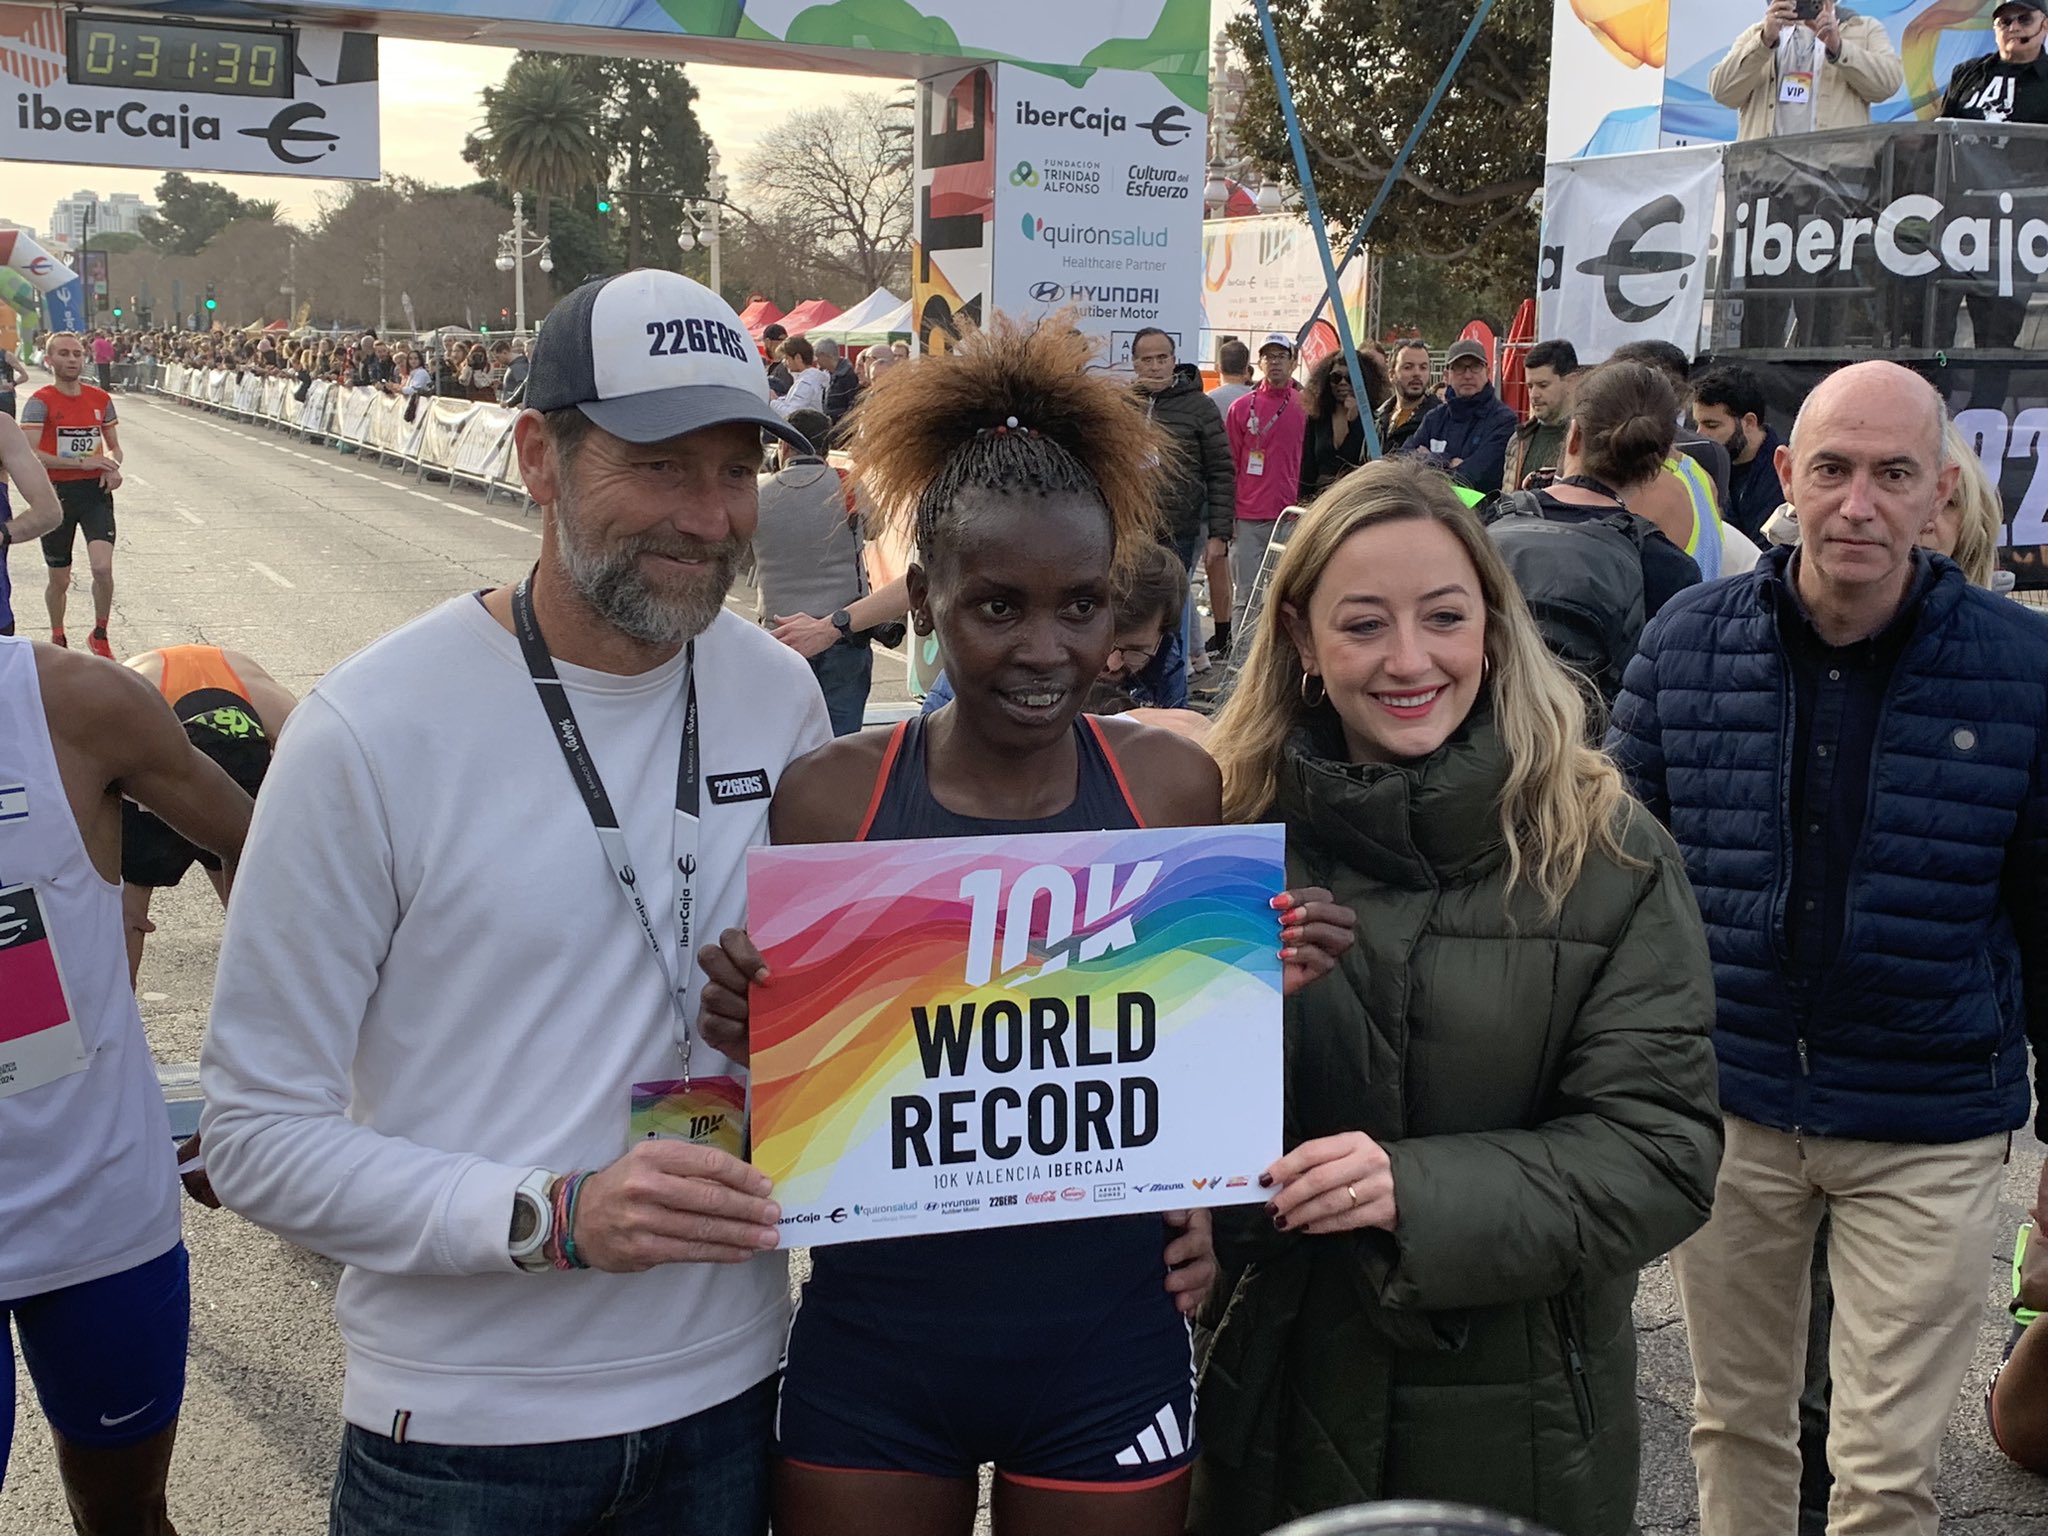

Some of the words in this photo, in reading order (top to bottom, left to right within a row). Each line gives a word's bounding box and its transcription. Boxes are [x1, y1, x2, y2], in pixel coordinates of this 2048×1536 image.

[86, 31, 277, 87] 0:31:30
[1786, 86, 1805, 97] VIP
[18, 92, 221, 149] iberCaja
[1016, 101, 1127, 137] iberCaja
[1044, 168, 1101, 183] TRINIDAD
[1128, 164, 1177, 183] Cultura
[1177, 173, 1190, 184] del
[1044, 182, 1101, 195] ALFONSO
[1126, 180, 1190, 200] Esfuerzo
[1043, 224, 1168, 250] quirónsalud
[1062, 255, 1123, 271] Healthcare
[1125, 258, 1167, 272] Partner
[1070, 285, 1159, 304] HYUNDAI
[1120, 306, 1159, 320] Motor
[646, 318, 748, 363] 226ERS
[71, 439, 93, 452] 692
[581, 765, 597, 791] BANCO
[714, 776, 763, 798] 226ERS
[679, 887, 694, 948] iberCaja
[958, 861, 1164, 988] 10K
[910, 991, 1156, 1079] WORLD
[688, 1113, 726, 1139] 10K
[890, 1077, 1159, 1170] RECORD
[933, 1172, 959, 1189] 10K
[966, 1166, 1041, 1187] VALENCIA
[1048, 1158, 1124, 1178] IBERCAJA
[941, 1199, 981, 1209] HYUNDAI
[989, 1195, 1018, 1207] 226ERS
